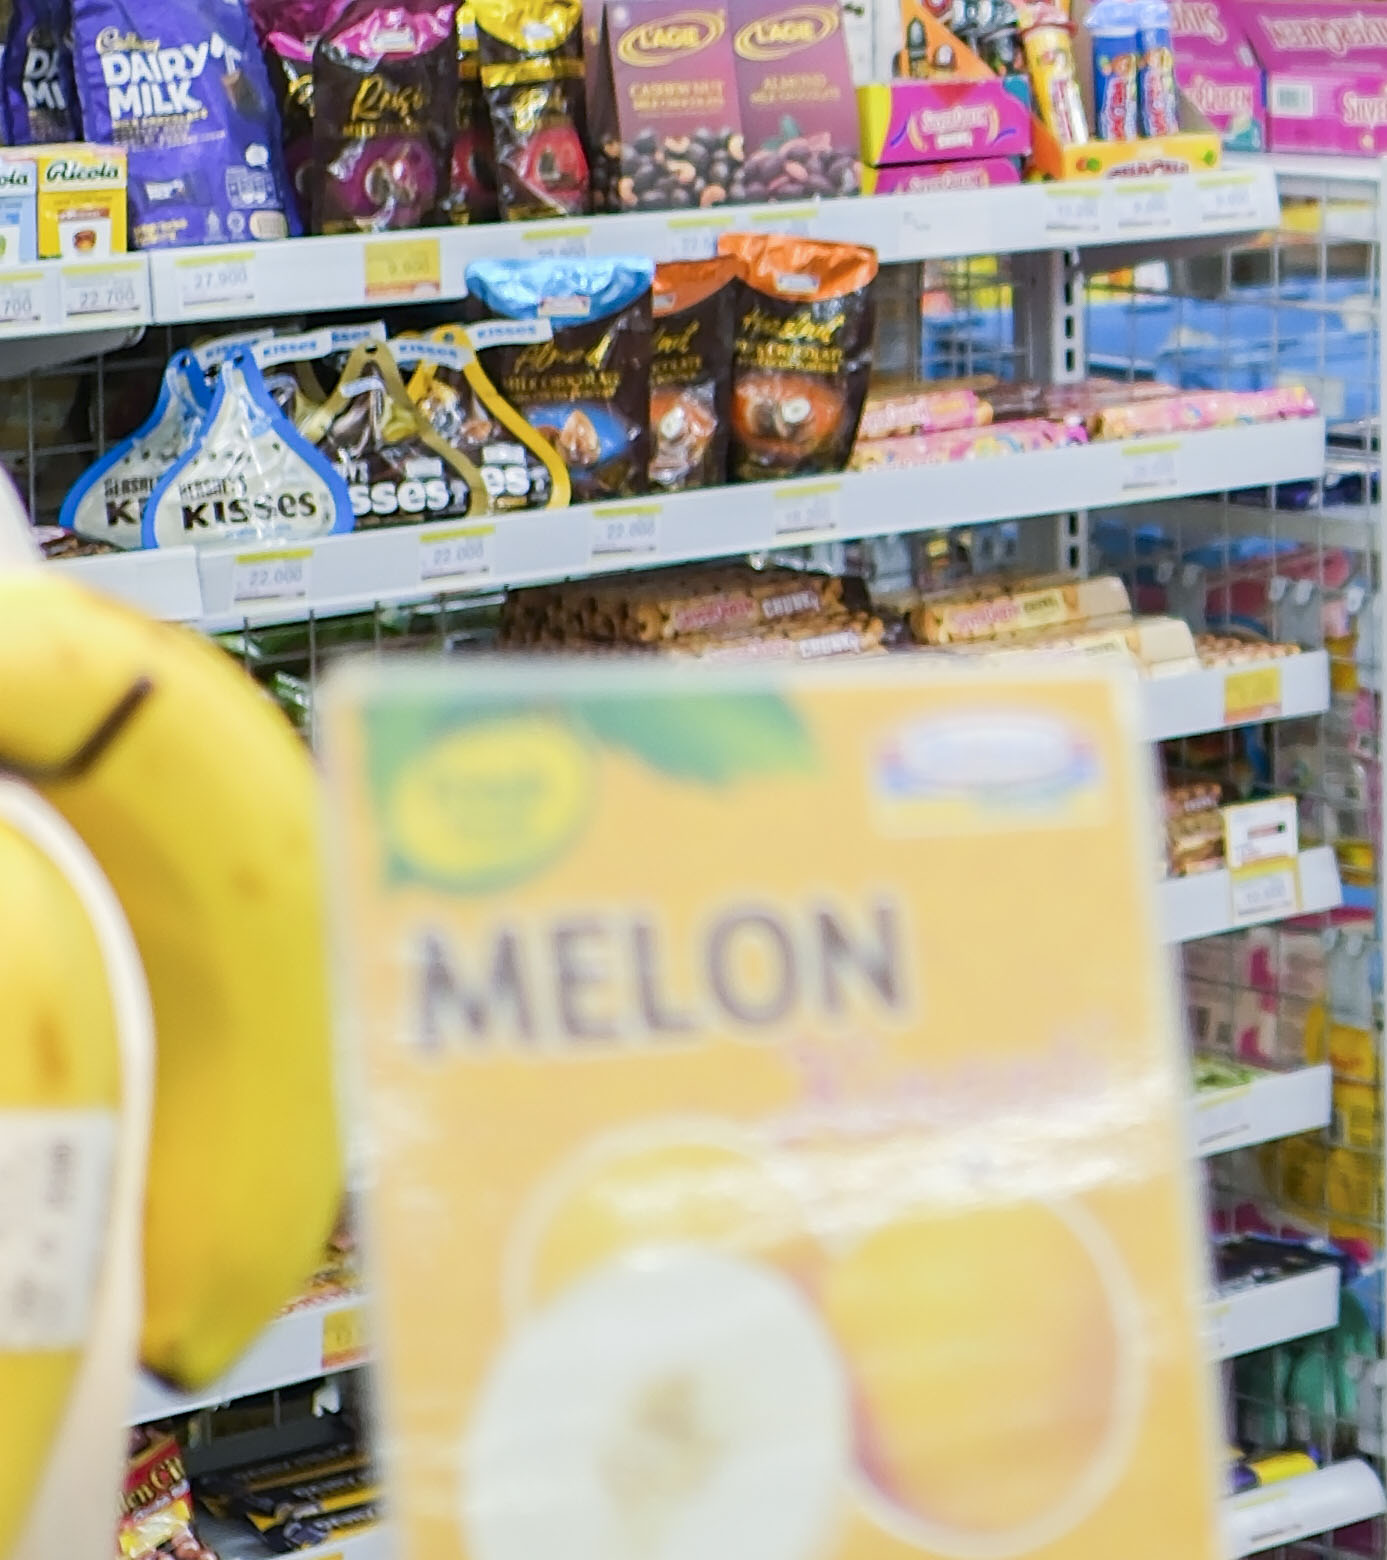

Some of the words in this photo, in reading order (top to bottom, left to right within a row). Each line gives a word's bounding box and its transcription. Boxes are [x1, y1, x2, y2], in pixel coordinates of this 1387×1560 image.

[101, 40, 208, 86] DAIRY
[109, 82, 202, 120] MILK
[46, 158, 120, 183] Ricola
[414, 894, 908, 1050] MELON
